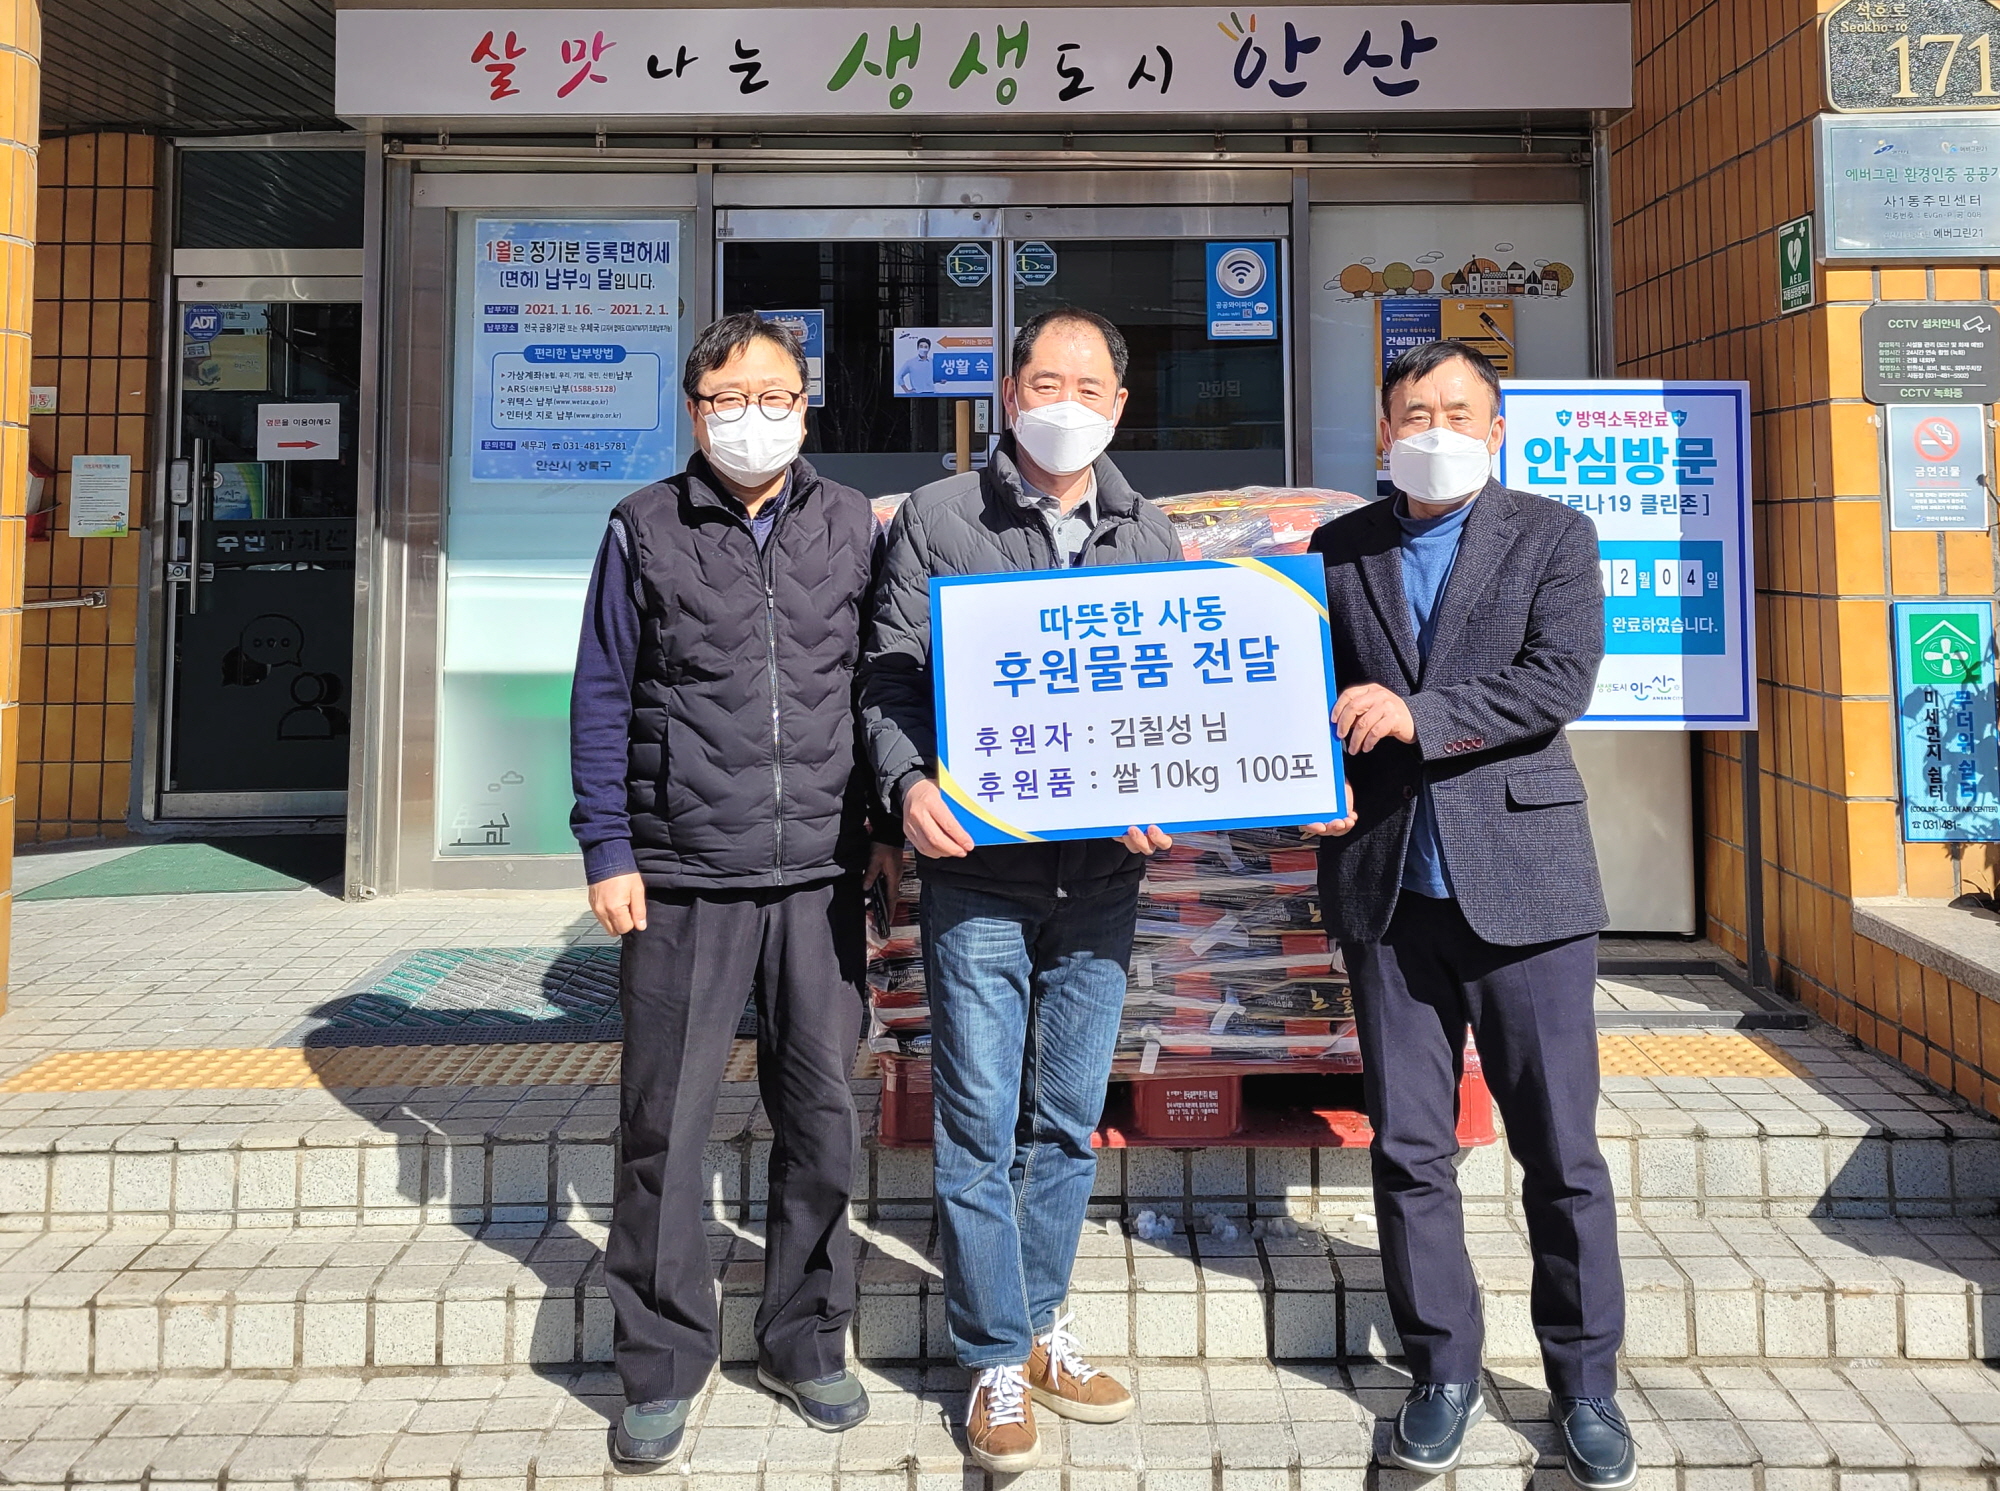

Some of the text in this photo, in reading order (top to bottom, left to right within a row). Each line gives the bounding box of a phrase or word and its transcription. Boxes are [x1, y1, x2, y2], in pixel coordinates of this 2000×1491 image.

[1840, 21, 1908, 33] Seokho-ro
[826, 20, 1173, 109] 생생도시
[1234, 19, 1438, 97] 안산
[1886, 33, 2000, 98] 171
[1845, 168, 1898, 183] 에버그린
[1904, 167, 1957, 183] 환경인증
[1884, 195, 1981, 207] 사1동주민센터
[1933, 228, 1983, 239] 에버그린21
[486, 240, 670, 264] 1월은 정기분 등록면허세
[545, 268, 591, 290] 납부의
[598, 269, 655, 290] 달입니다.
[1789, 272, 1802, 285] AED
[486, 305, 517, 314] 납부기간
[525, 304, 558, 315] 2021.
[561, 305, 572, 315] 1.
[574, 304, 593, 315] 16.
[610, 304, 642, 315] 2021.
[645, 305, 656, 315] 2.
[658, 305, 669, 315] 1.
[1215, 301, 1253, 309] 공공와이파이
[190, 316, 217, 329] ADT
[486, 323, 517, 332] 납부장소
[523, 323, 538, 333] 전국
[539, 323, 566, 333] 금융기관
[579, 323, 600, 333] 우체국
[1888, 318, 1961, 329] CCTV 설치안내
[534, 347, 614, 360] 편리한 납부방법
[941, 358, 989, 375] 생활 속
[1900, 388, 1963, 398] CCTV 녹화중
[507, 397, 533, 406] 위택스
[506, 410, 533, 420] 인터넷
[536, 411, 553, 420] 지로
[1576, 410, 1669, 428] 방역소독완료
[266, 418, 331, 427] 옆문을 이용하세요
[484, 441, 626, 450] 문의전화 세무과 031-481-5781
[536, 460, 612, 472] 안산시 상록구
[1524, 436, 1718, 486] 안심방문
[1915, 466, 1960, 477] 금연건물
[1039, 595, 1227, 641] 따뜻한 사동
[1612, 616, 1718, 634] 완료하였습니다.
[993, 634, 1281, 697] 후원물품 전달
[1109, 713, 1193, 750] 김칠성
[1201, 711, 1228, 743] 님
[1924, 690, 1943, 802] 미세먼지 쉼터
[1954, 690, 1977, 802] 무더위 쉼터
[1111, 762, 1140, 795] 쌀
[1150, 758, 1220, 793] 10kg
[1236, 752, 1318, 783] 100포
